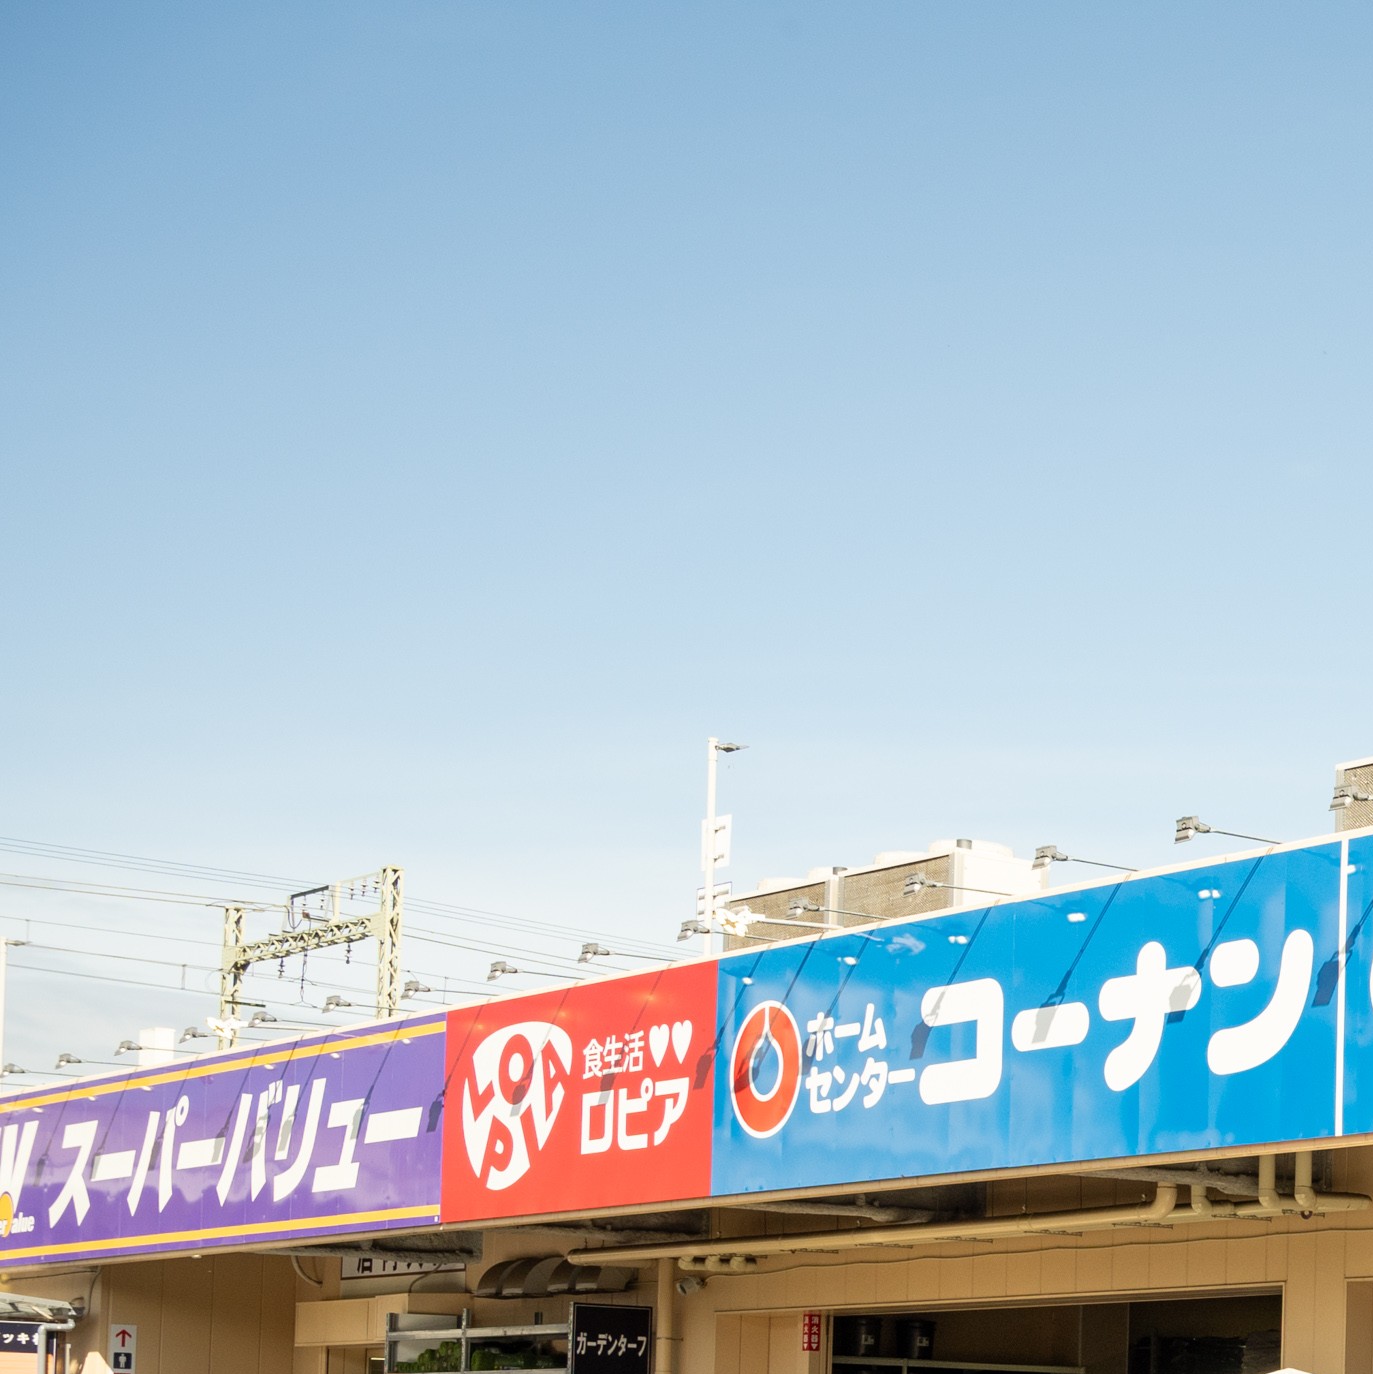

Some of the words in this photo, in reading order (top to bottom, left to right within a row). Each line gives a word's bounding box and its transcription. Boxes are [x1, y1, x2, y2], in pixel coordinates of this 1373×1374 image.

[806, 1002, 888, 1062] ホーム
[919, 929, 1315, 1106] コーナン
[582, 1030, 645, 1080] 食生活
[804, 1057, 916, 1114] センター
[580, 1077, 690, 1155] ロピア
[49, 1076, 423, 1229] スーパーバリュー
[576, 1331, 647, 1357] ガーデンターフ
